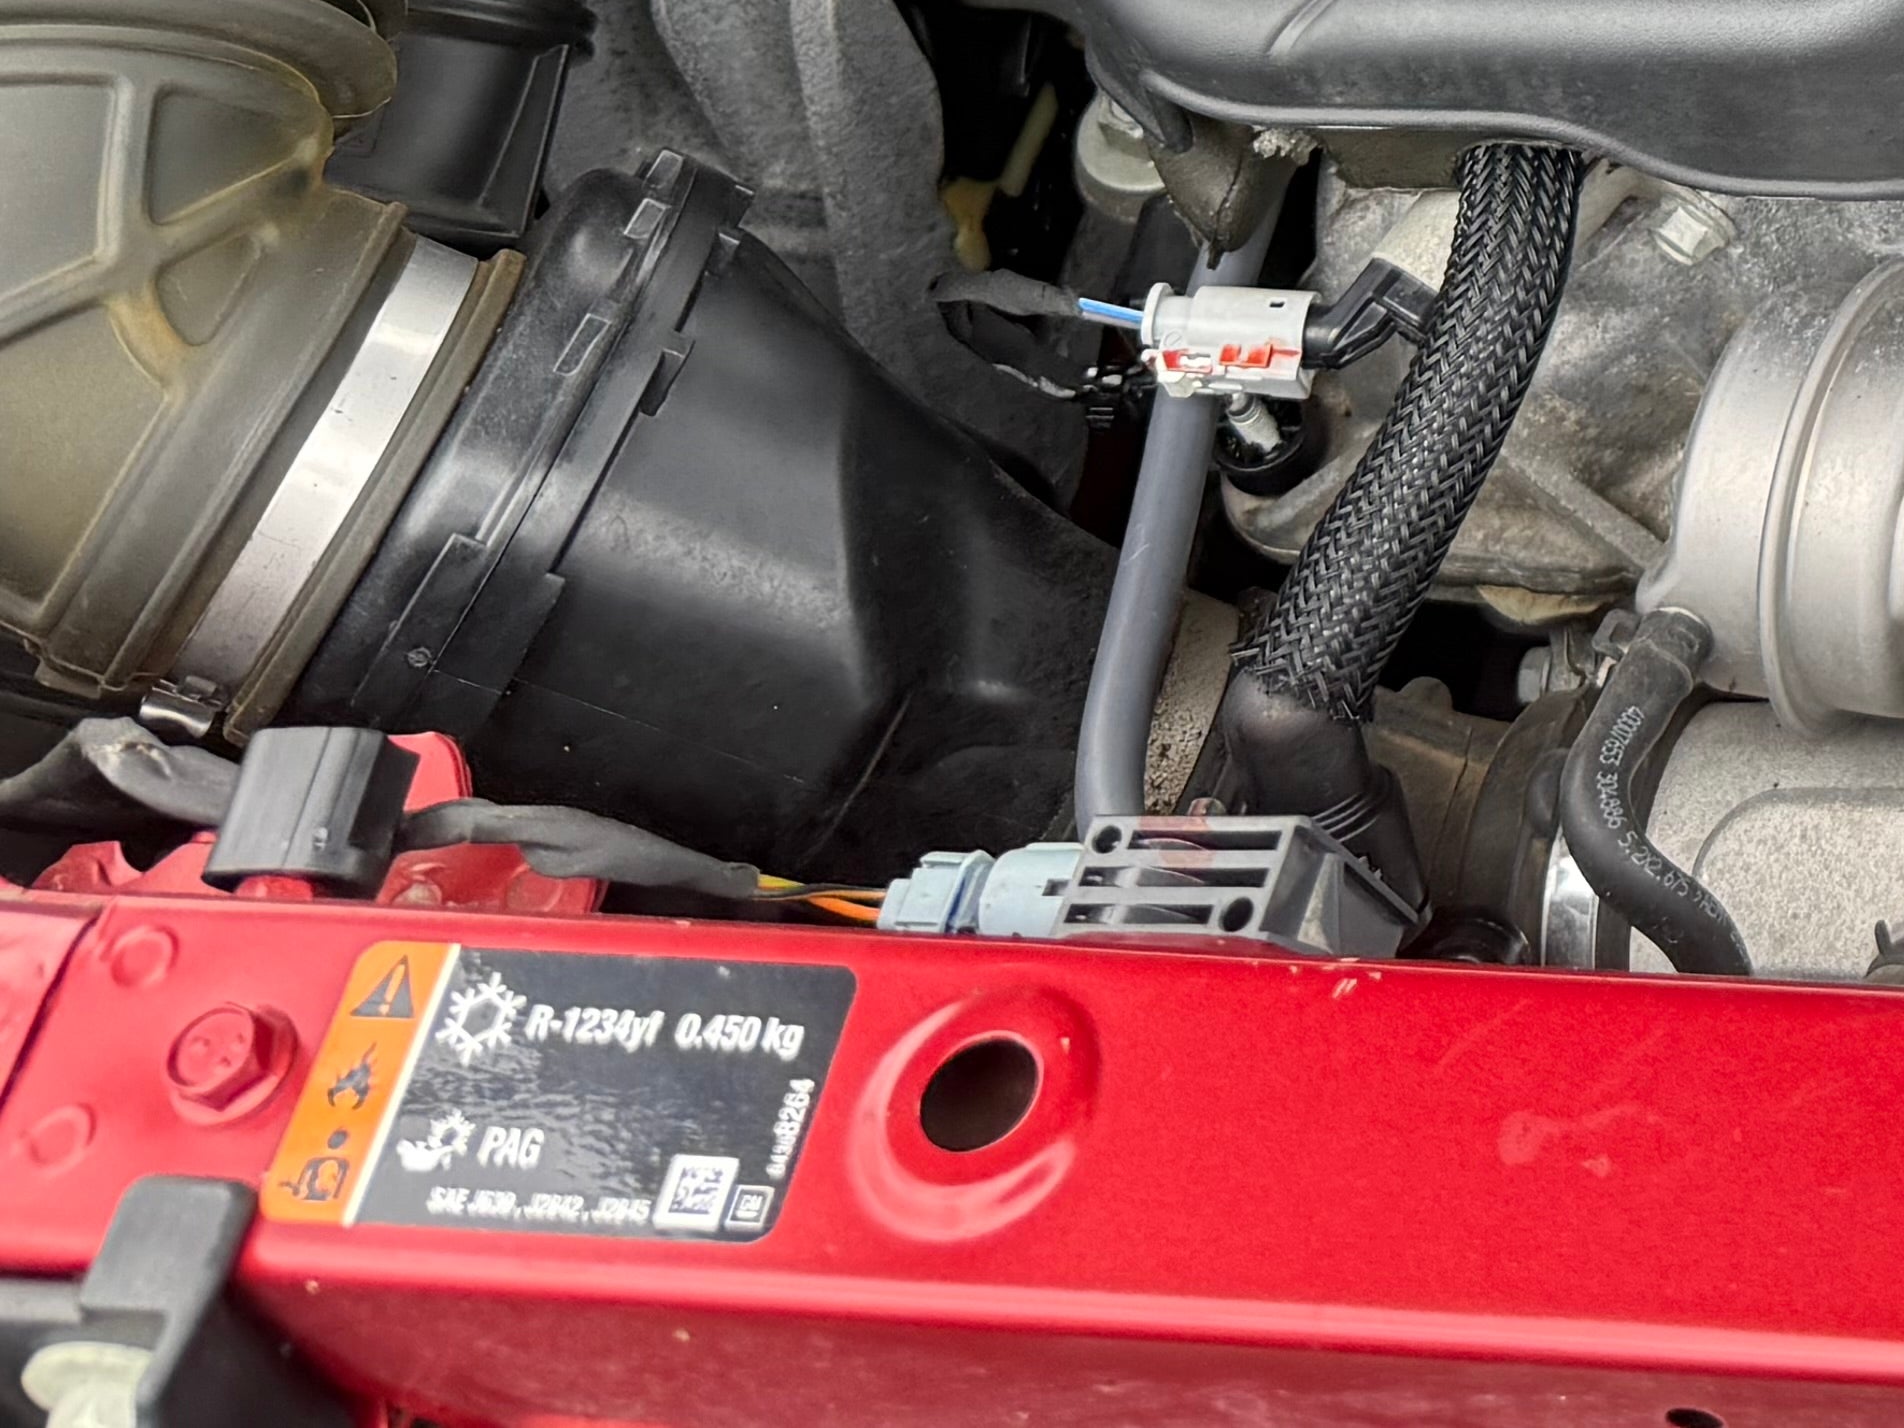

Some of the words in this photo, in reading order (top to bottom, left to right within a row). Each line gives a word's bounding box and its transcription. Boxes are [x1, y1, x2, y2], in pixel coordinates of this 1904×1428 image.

[525, 1005, 666, 1053] R-1234yf
[674, 1013, 761, 1052] 0.450
[762, 1016, 805, 1061] kg
[478, 1126, 544, 1169] PAG
[427, 1186, 466, 1214] SAE
